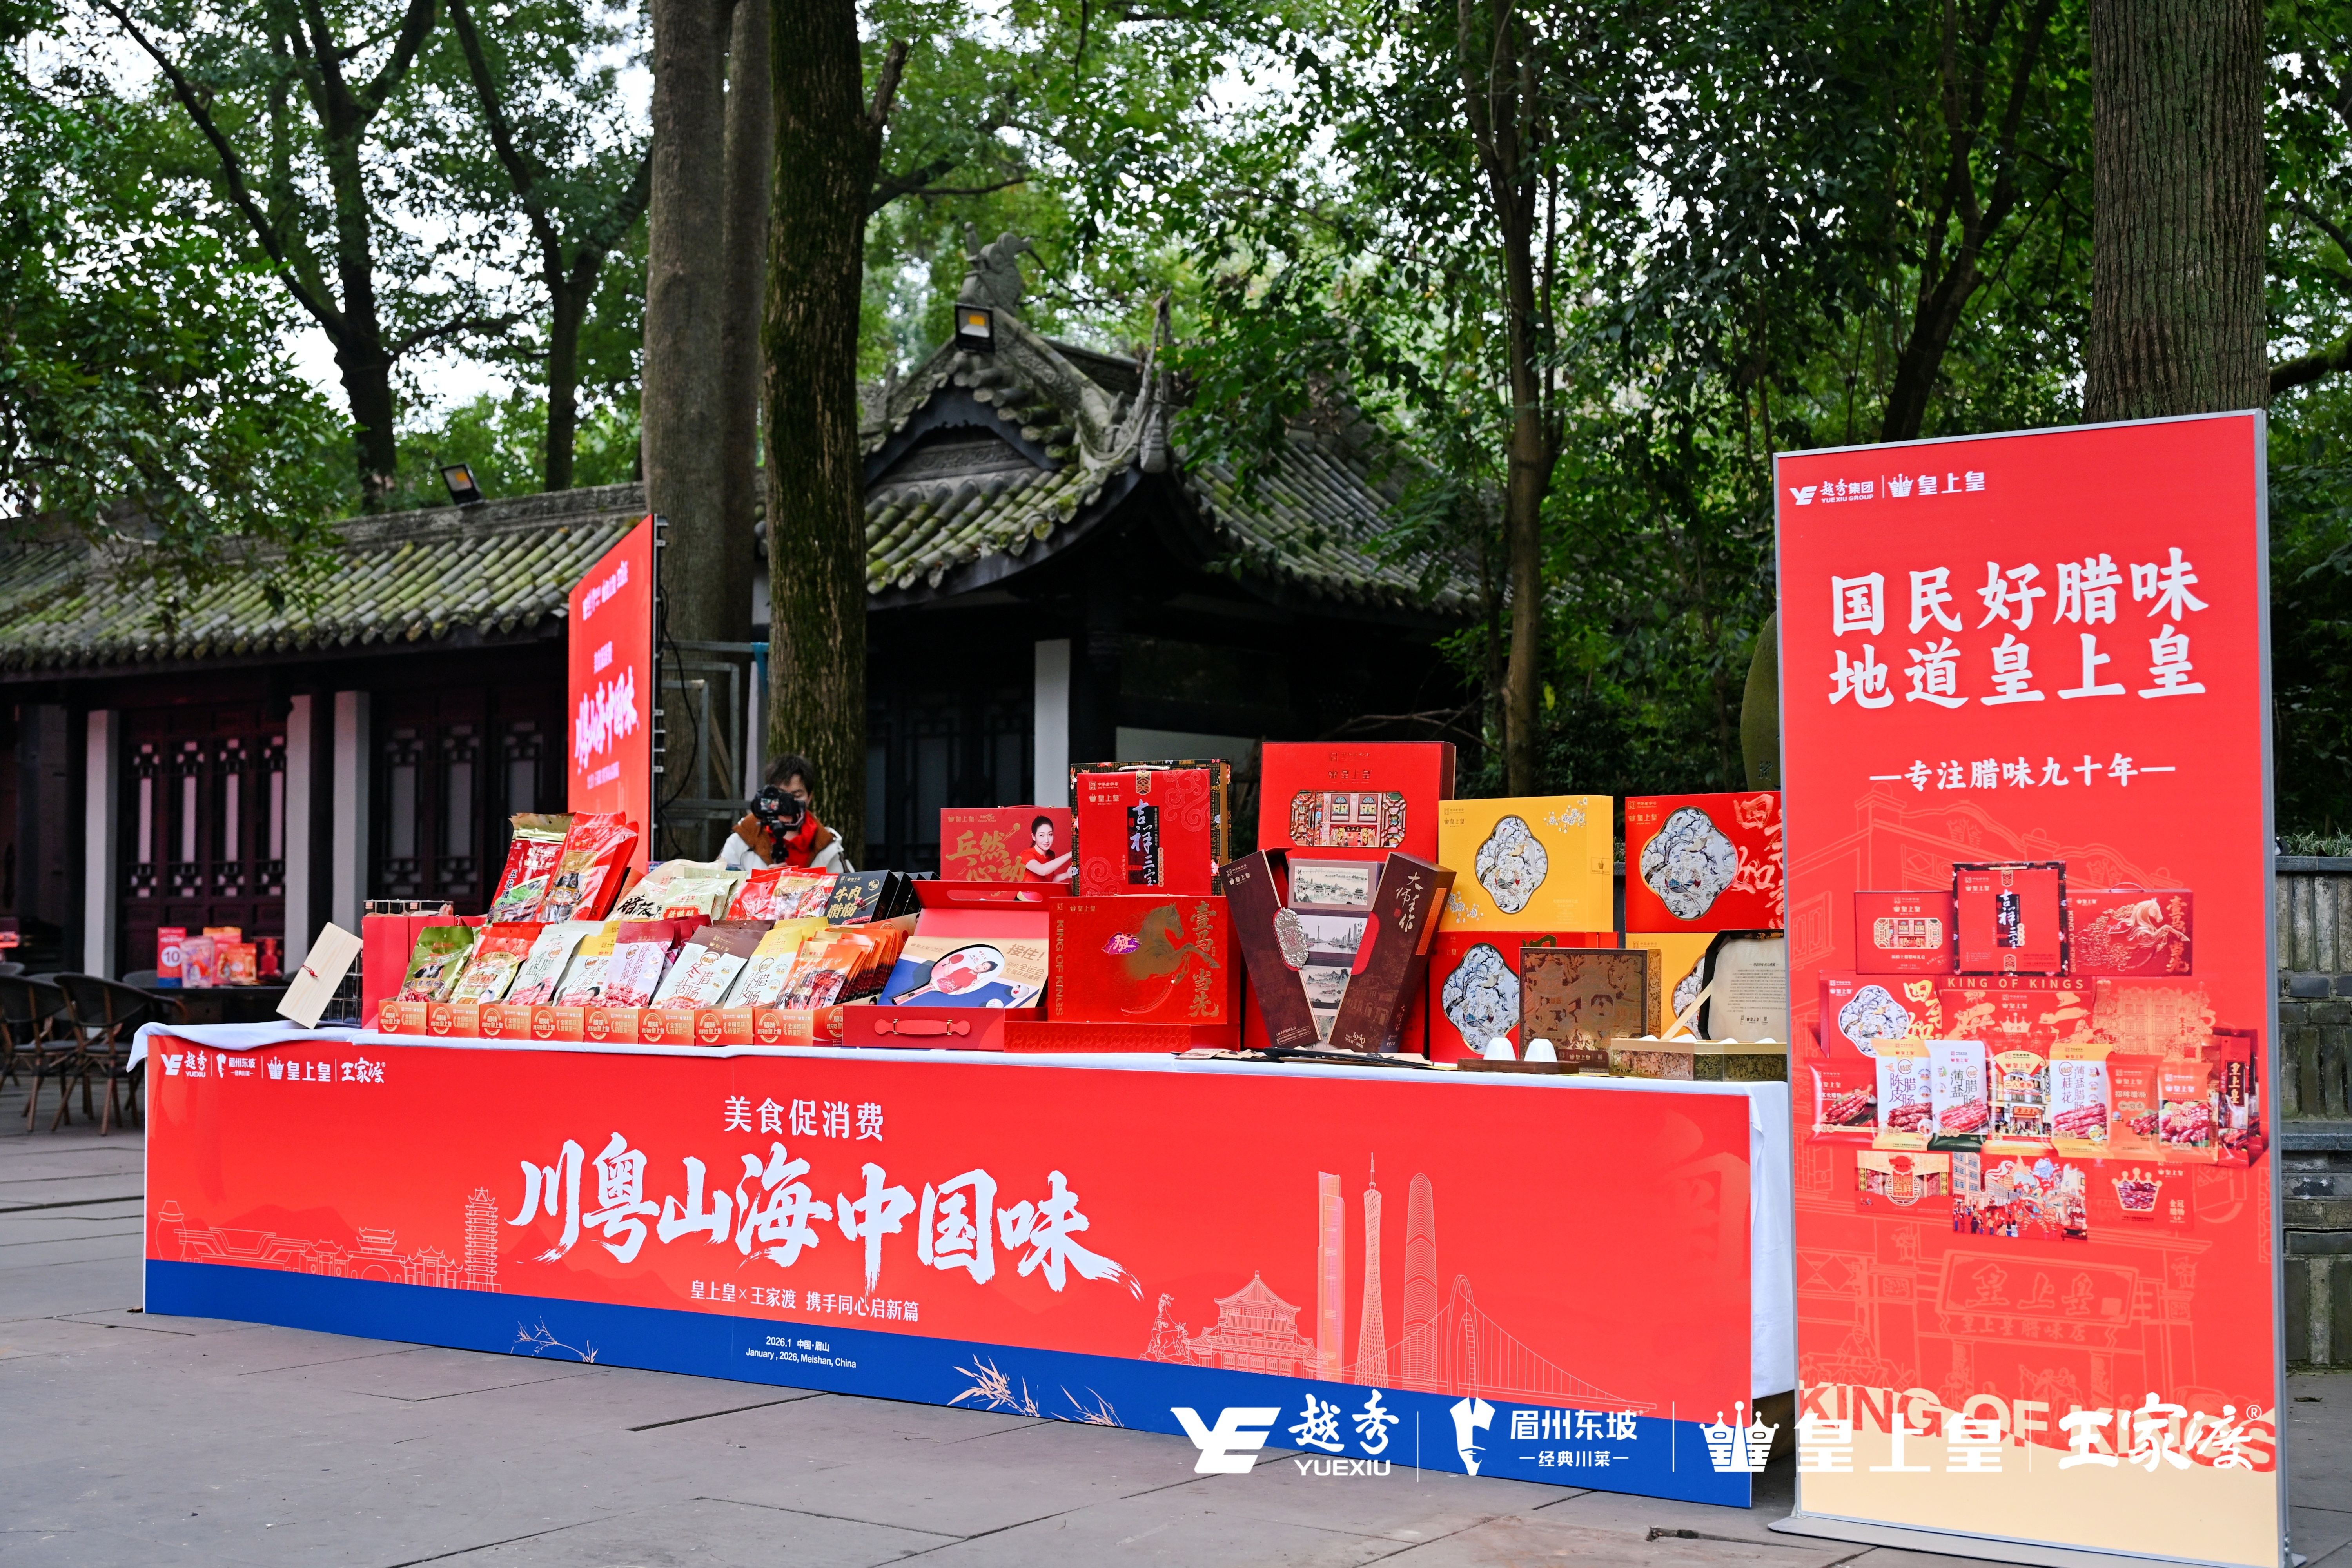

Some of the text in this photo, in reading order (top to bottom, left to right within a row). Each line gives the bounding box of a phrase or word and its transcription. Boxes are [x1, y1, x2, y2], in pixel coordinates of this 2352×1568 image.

[1820, 478, 1874, 497] 越秀集团
[1918, 471, 1985, 495] 皇上皇
[1831, 547, 2209, 637] 国民好腊味
[1828, 624, 2206, 709] 地道皇上皇
[1341, 770, 1370, 780] 皇上皇
[1637, 813, 1658, 822] 皇上皇
[1129, 798, 1157, 887] 吉祥三宝
[497, 869, 518, 910] 五花腊肉
[1235, 872, 1250, 883] 皇上皇
[834, 886, 862, 902] 牛肉
[827, 902, 858, 919] 腊肠
[1998, 889, 2019, 949] 吉祥三宝
[2069, 933, 2075, 945] OF
[164, 951, 180, 963] 10
[1007, 943, 1045, 962] 接住!
[670, 962, 702, 997] 冬菇
[1005, 968, 1041, 982] 专属乒乓套装
[1007, 962, 1045, 977] 你的全运会
[1055, 920, 1064, 1016] KING OF KINGS
[686, 971, 715, 1000] 腊肠
[1947, 978, 2083, 989] KING OF KINGS
[1352, 1031, 1366, 1044] 1940
[184, 1050, 208, 1071] 越秀
[228, 1057, 256, 1069] 眉州东坡
[287, 1060, 331, 1082] 皇上皇
[341, 1057, 385, 1084] 王家渡
[1888, 1073, 1904, 1103] 陈皮
[1900, 1078, 1916, 1107] 腊肠
[1950, 1069, 1966, 1098] 薄盐
[1963, 1080, 1978, 1108] 腊肠
[2062, 1077, 2074, 1103] 桂花
[2115, 1090, 2146, 1098] 招牌腊肠
[2228, 1062, 2241, 1104] 皇上皇
[724, 1095, 884, 1142] 美食促消费
[506, 1131, 1143, 1302] 川粤山海中国味
[806, 1290, 919, 1322] 携手同心启新篇
[766, 1336, 829, 1352] 2026.1 中国·眉山
[779, 1352, 799, 1364] 2026,
[800, 1354, 833, 1367] Meishan,
[835, 1357, 857, 1368] China
[1961, 1394, 2051, 1448] OF
